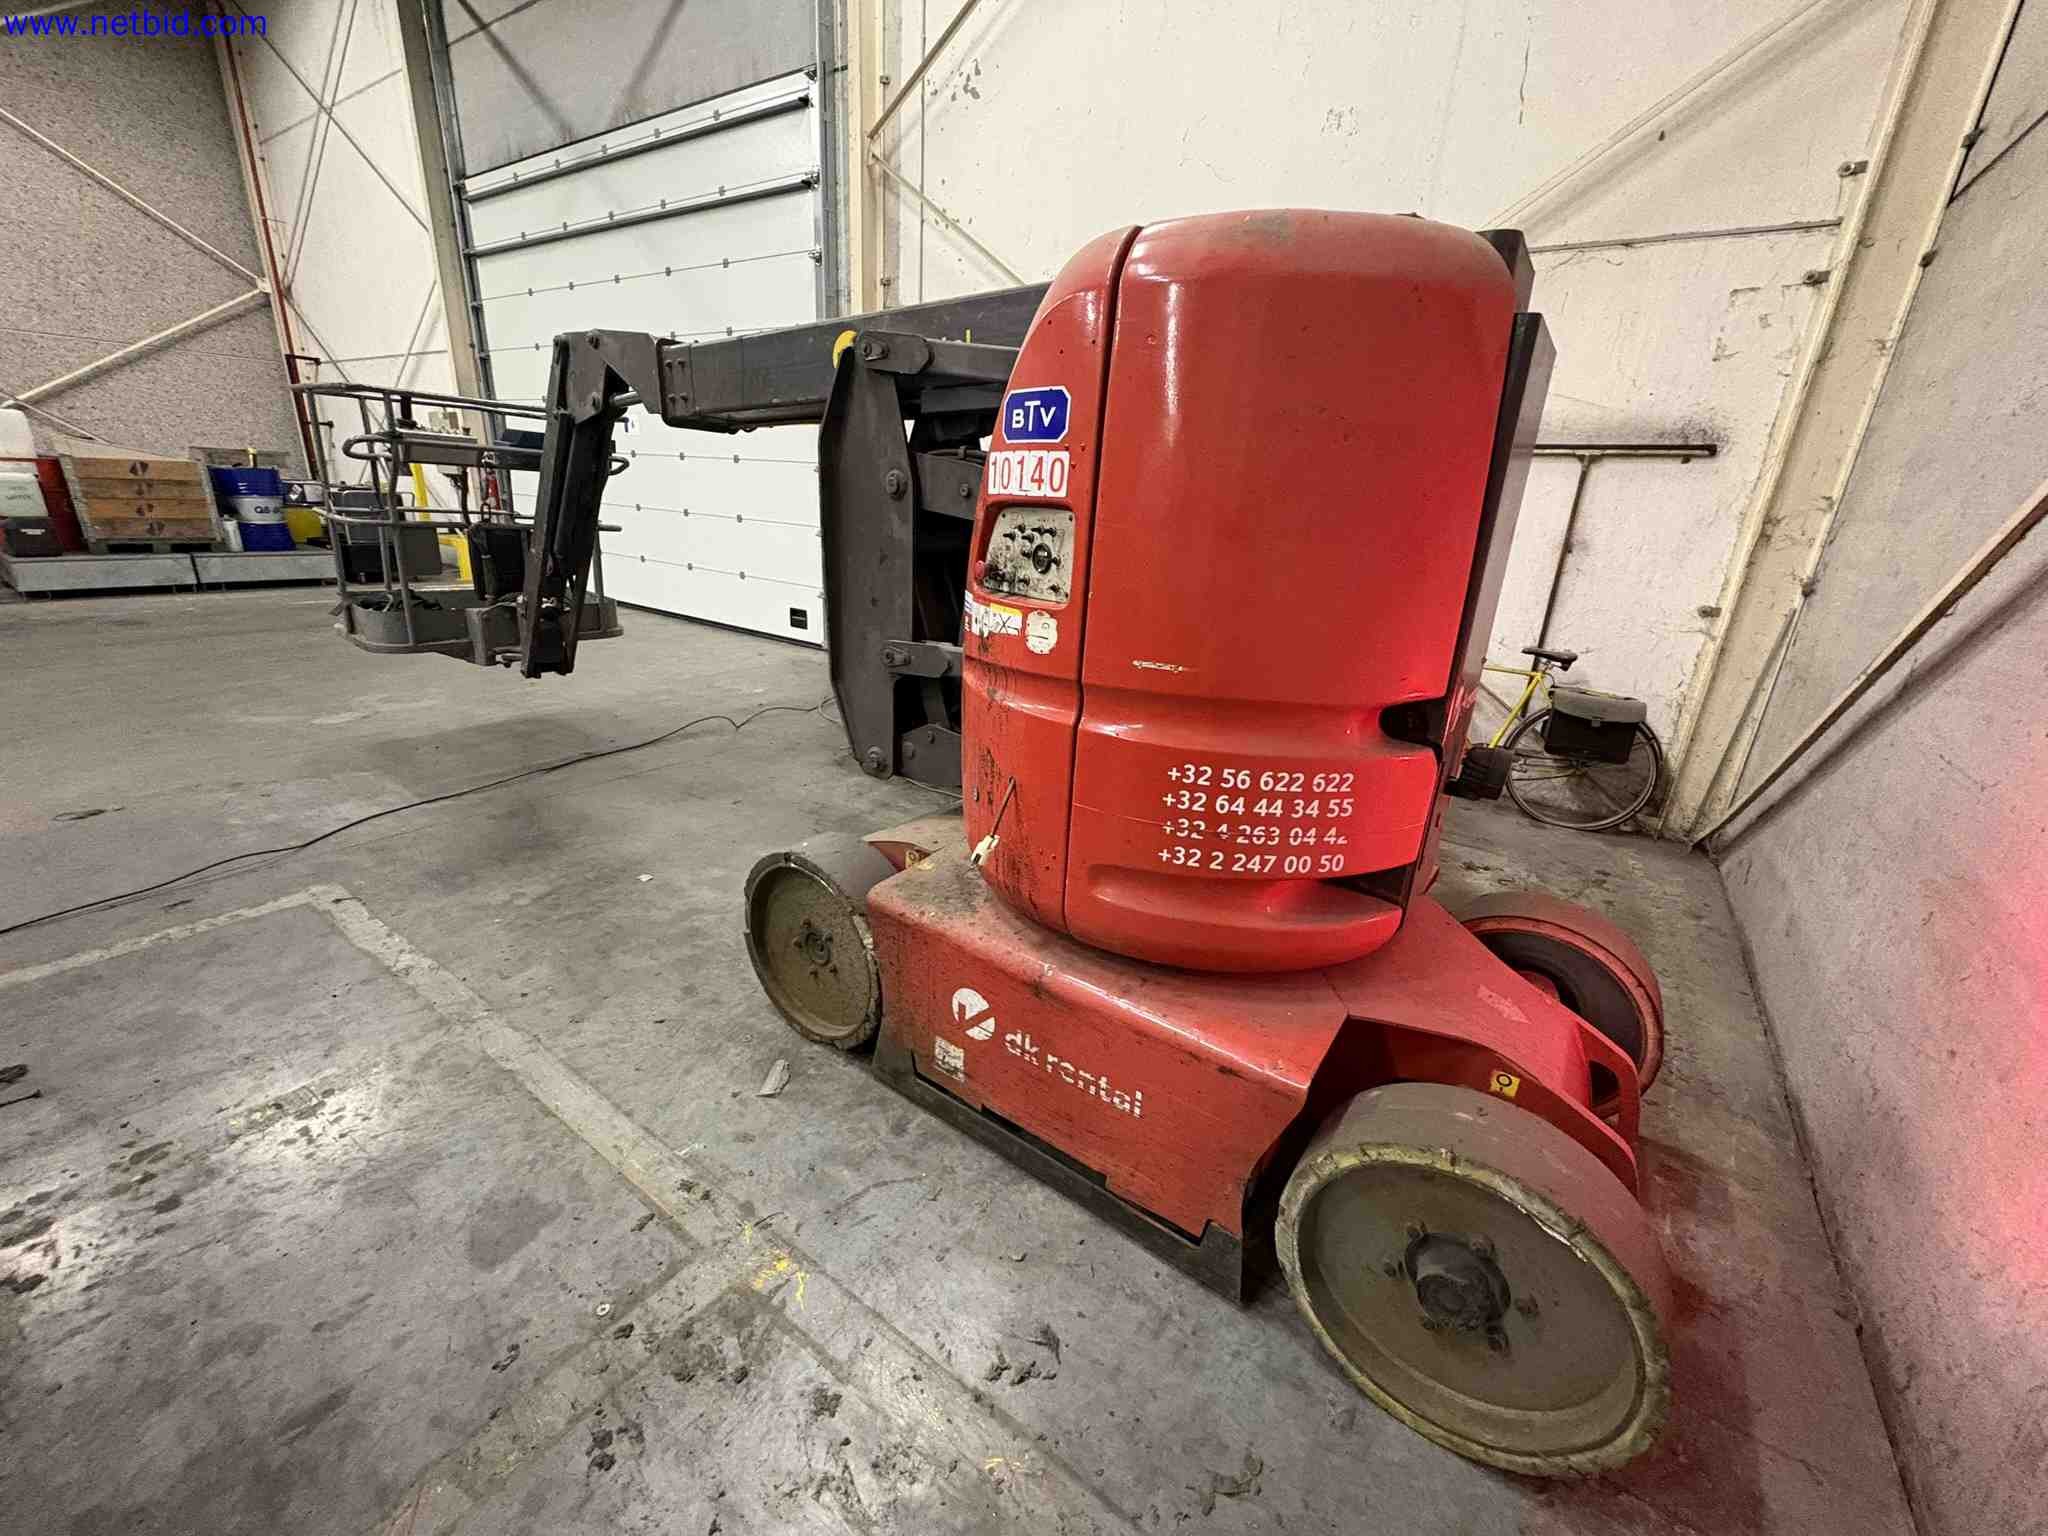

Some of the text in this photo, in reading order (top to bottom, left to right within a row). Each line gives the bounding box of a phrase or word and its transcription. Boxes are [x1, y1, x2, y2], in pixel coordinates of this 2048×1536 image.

[1011, 400, 1057, 431] BTV
[991, 456, 1066, 492] 10140
[1167, 764, 1354, 793] +32 56 622 622
[1162, 790, 1355, 818] +32 64 44 34 55
[1162, 818, 1206, 840] +32
[1216, 823, 1232, 840] 4
[1236, 824, 1281, 846] 263
[1288, 827, 1317, 846] 04
[1158, 846, 1345, 874] +32 2 247 00 50
[1003, 1029, 1041, 1067] dk
